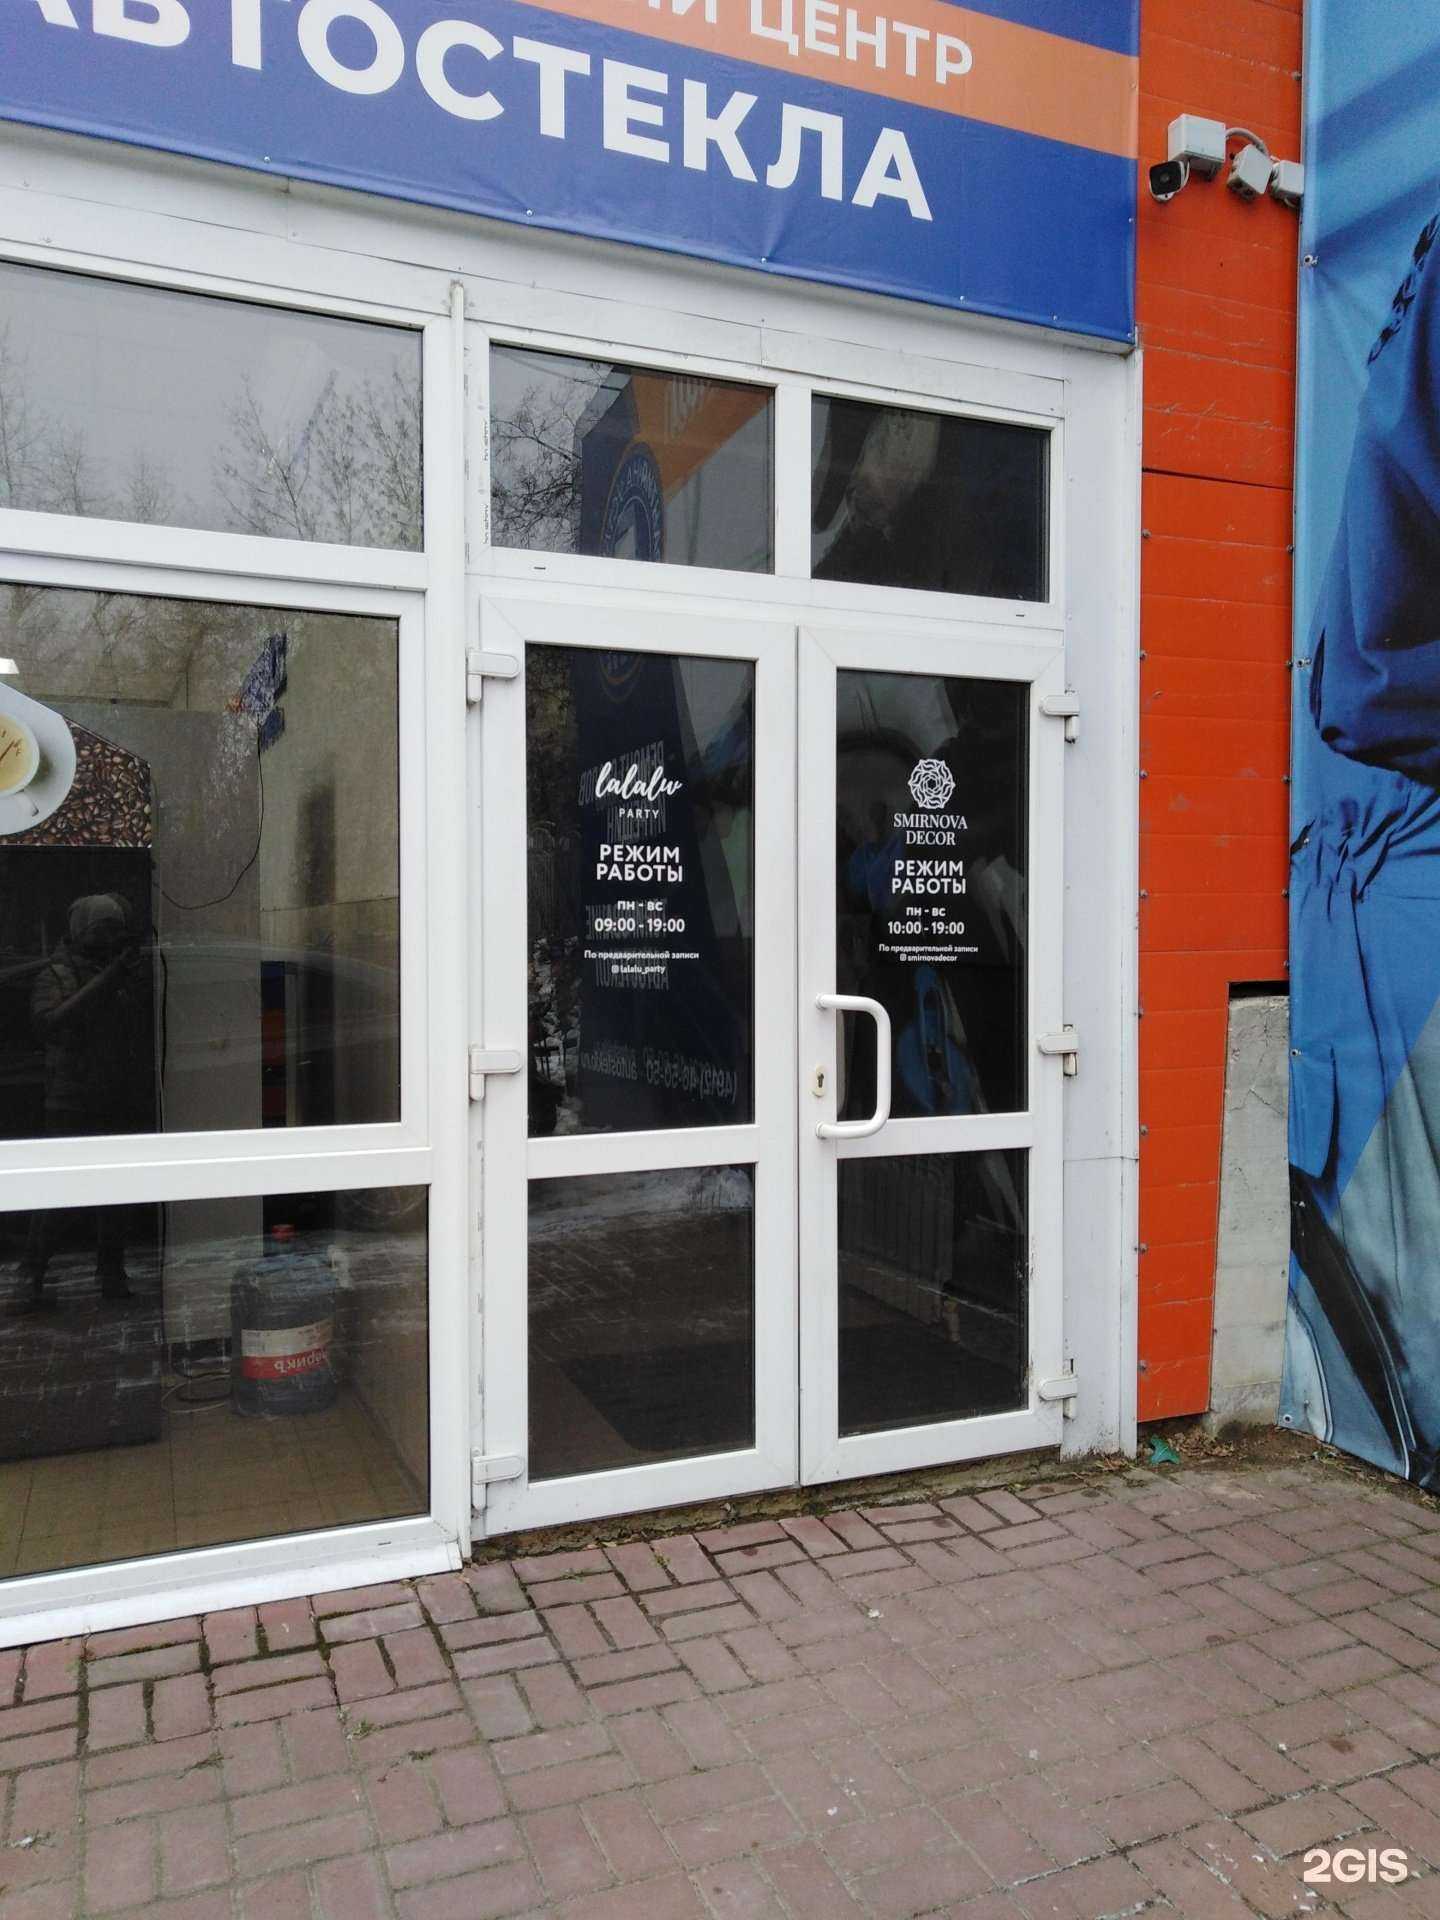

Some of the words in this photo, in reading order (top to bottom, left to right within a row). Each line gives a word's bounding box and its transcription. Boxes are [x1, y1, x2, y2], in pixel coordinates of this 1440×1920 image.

[750, 0, 973, 85] ЦЕНТР
[619, 807, 659, 819] PARTY
[893, 813, 968, 829] SMIRNOVA
[906, 831, 956, 845] DECOR
[600, 844, 679, 863] РЕЖИМ
[596, 863, 683, 882] РАБОТЫ
[895, 860, 963, 876] РЕЖИМ
[892, 878, 966, 894] РАБОТЫ
[595, 917, 636, 932] 09:00
[647, 918, 685, 932] 19:00
[888, 921, 921, 934] 10:00
[931, 921, 965, 934] 19:00
[584, 950, 597, 959] По
[598, 951, 670, 960] предварительной
